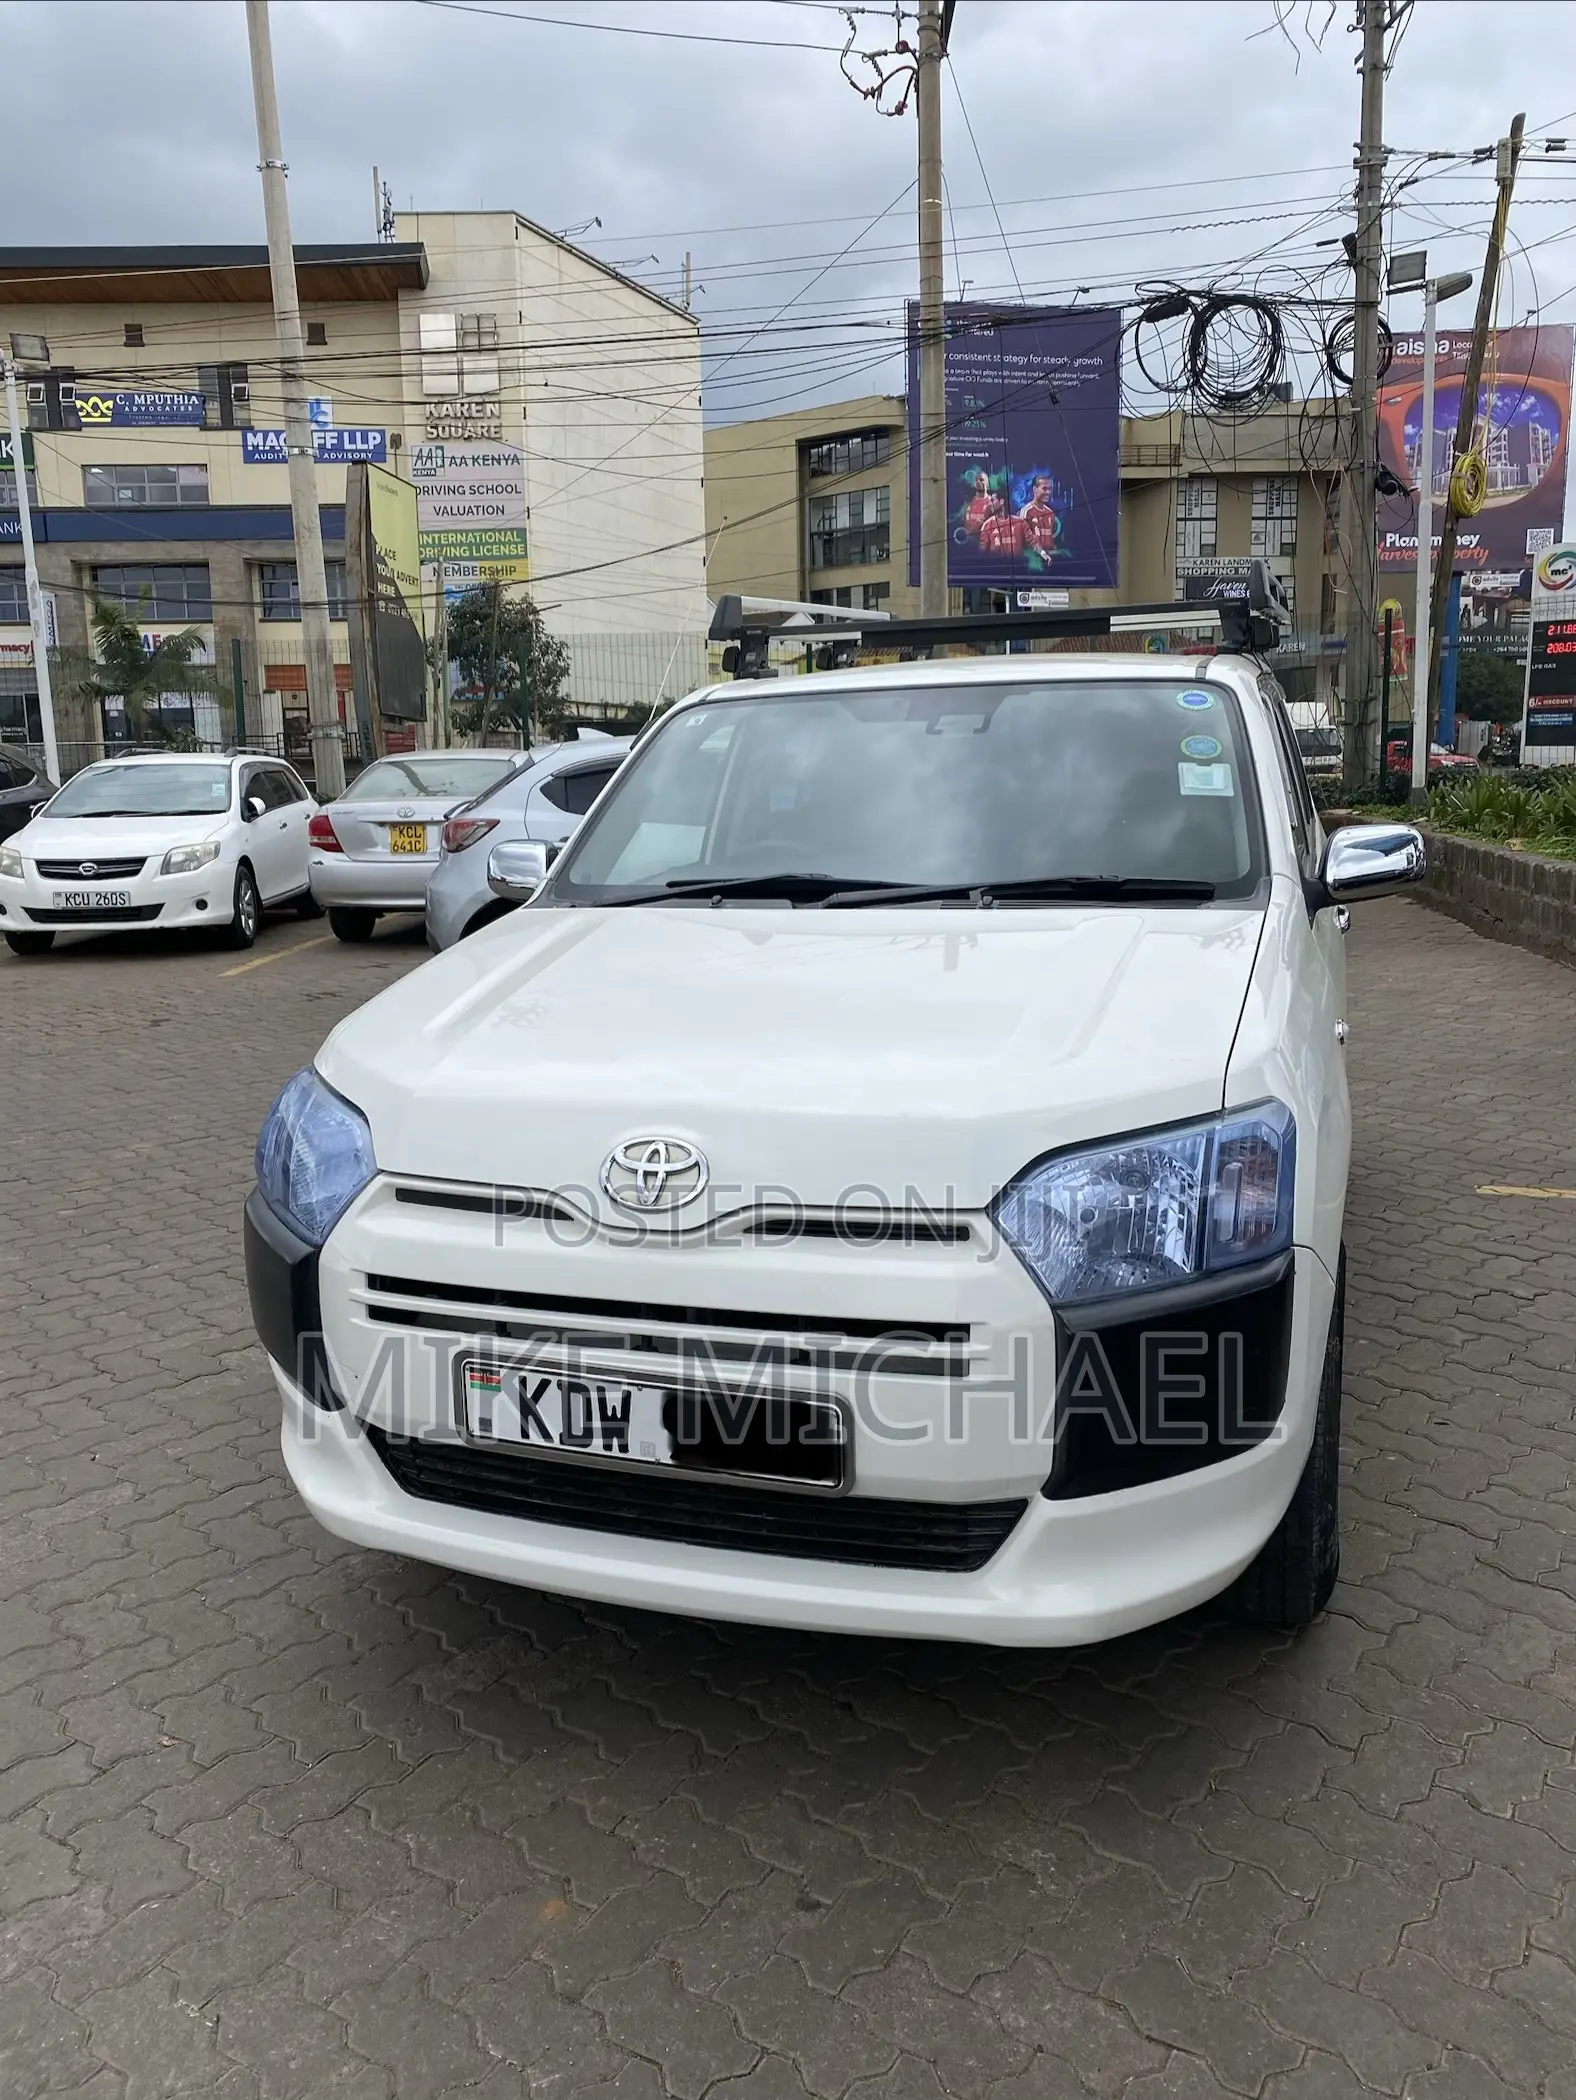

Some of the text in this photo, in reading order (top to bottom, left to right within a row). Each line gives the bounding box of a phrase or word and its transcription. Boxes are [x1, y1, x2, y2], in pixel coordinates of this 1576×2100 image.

[1393, 338, 1450, 355] aisa
[948, 352, 992, 362] consistent
[993, 354, 1028, 365] stategy
[1029, 354, 1042, 363] for
[1073, 356, 1103, 367] growth
[115, 394, 199, 405] C. MPUTHIA
[425, 402, 501, 420] KAREN
[426, 422, 502, 439] SQUARE
[343, 431, 382, 450] LLP
[323, 452, 373, 460] ADVISORY
[448, 455, 469, 467] AA
[471, 454, 521, 466] KENYA
[416, 484, 522, 497] DRIVING SCHOOL
[433, 505, 505, 516] VALUATION
[419, 530, 521, 544] INTERNATIONAL
[1385, 532, 1417, 548] Plan
[376, 544, 397, 561] PLACE
[472, 545, 525, 557] LICENSE
[1192, 558, 1271, 567] KAREN LANDMK
[376, 563, 419, 588] YOUR ADVERT
[1177, 567, 1236, 576] SHOPPING
[378, 581, 396, 597] HERE
[1223, 589, 1246, 598] WINES
[1276, 641, 1306, 653] KAREN
[398, 826, 422, 839] KCL
[65, 893, 90, 907] KCU
[517, 1374, 633, 1454] KDW
